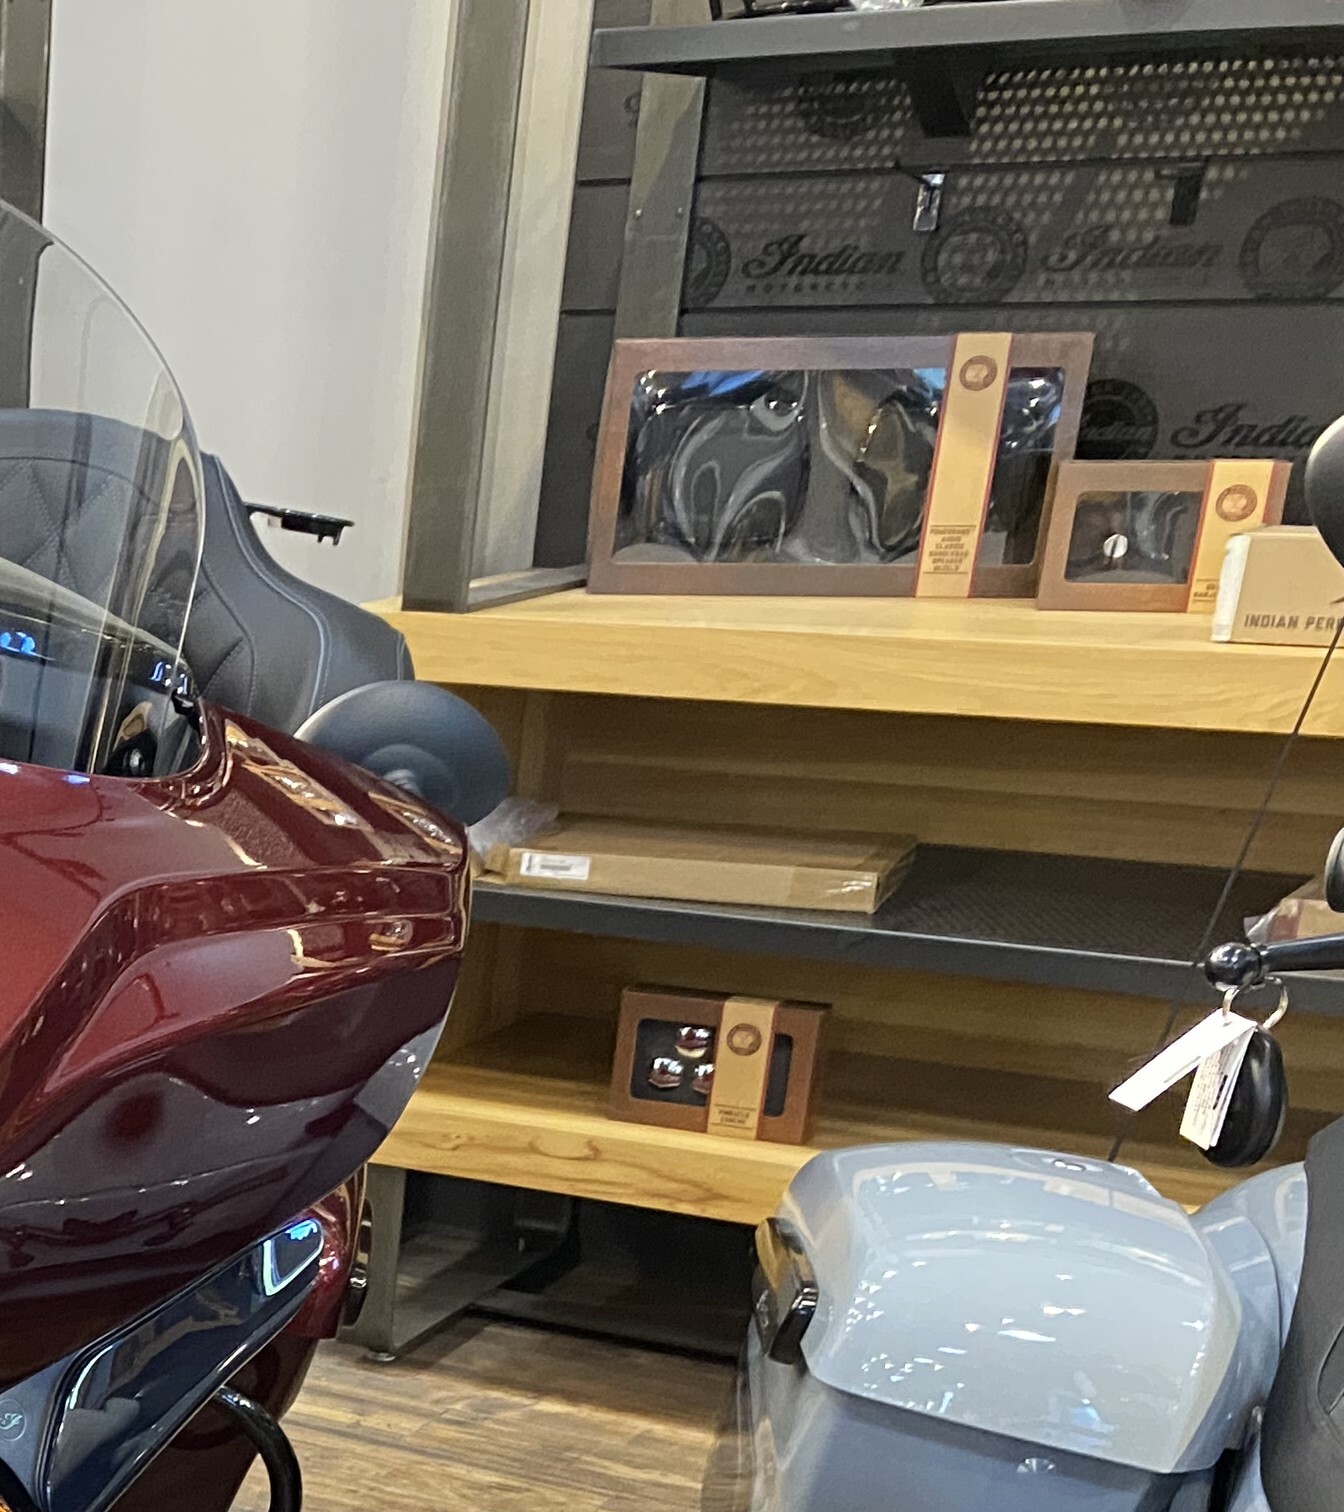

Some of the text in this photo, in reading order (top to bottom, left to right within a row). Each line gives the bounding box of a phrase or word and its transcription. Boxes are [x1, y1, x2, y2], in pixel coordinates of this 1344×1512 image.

[741, 233, 906, 280] Indian
[1170, 402, 1321, 449] India
[1244, 612, 1300, 629] INDIAN
